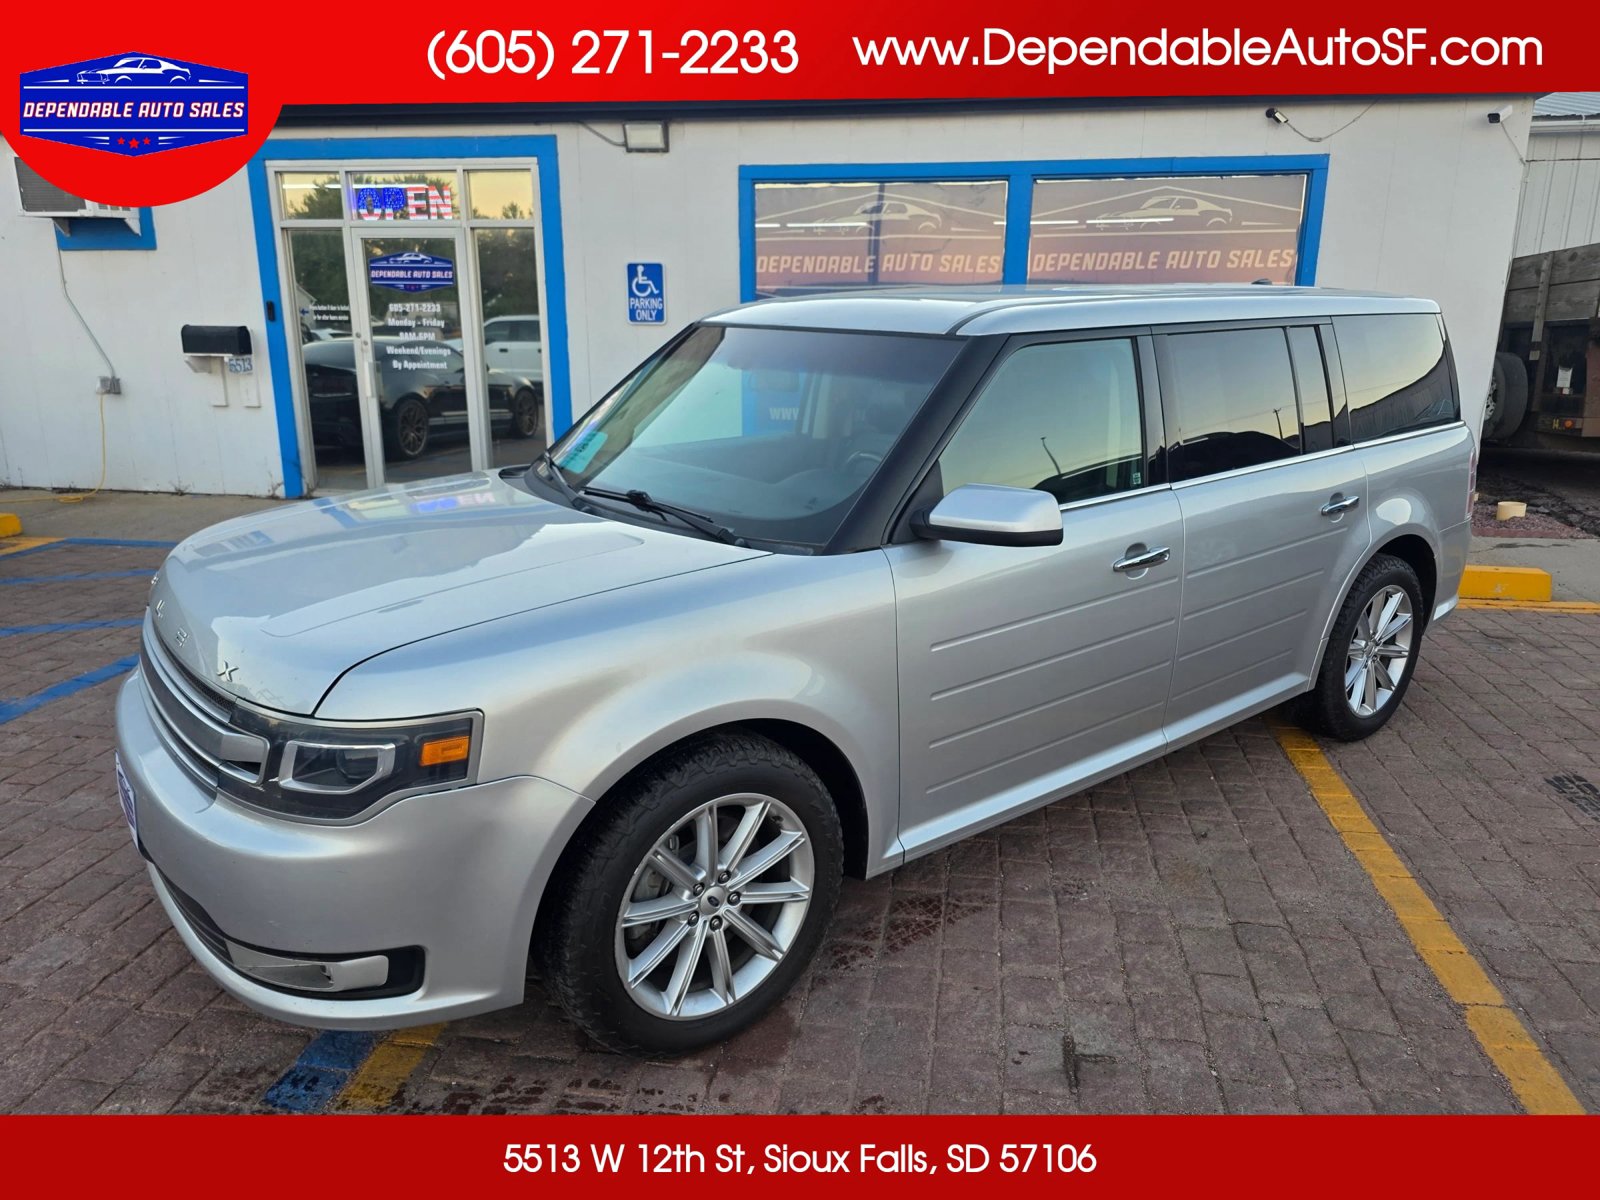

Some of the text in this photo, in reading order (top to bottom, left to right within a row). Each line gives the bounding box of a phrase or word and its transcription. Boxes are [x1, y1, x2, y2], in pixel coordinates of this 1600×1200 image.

[357, 185, 453, 220] OPEN
[756, 253, 1001, 273] DEPENDABLE AUTO SALES
[1031, 249, 1295, 272] DEPENDABLE AUTO SALES
[371, 270, 411, 278] DEPENDABLE
[413, 270, 431, 278] AUTO
[630, 297, 663, 310] PARKING
[635, 309, 657, 321] ONLY
[387, 318, 416, 328] Monday
[422, 318, 445, 328] Friday
[386, 346, 452, 356] Weekend/Evenings
[392, 360, 448, 370] By Appointment
